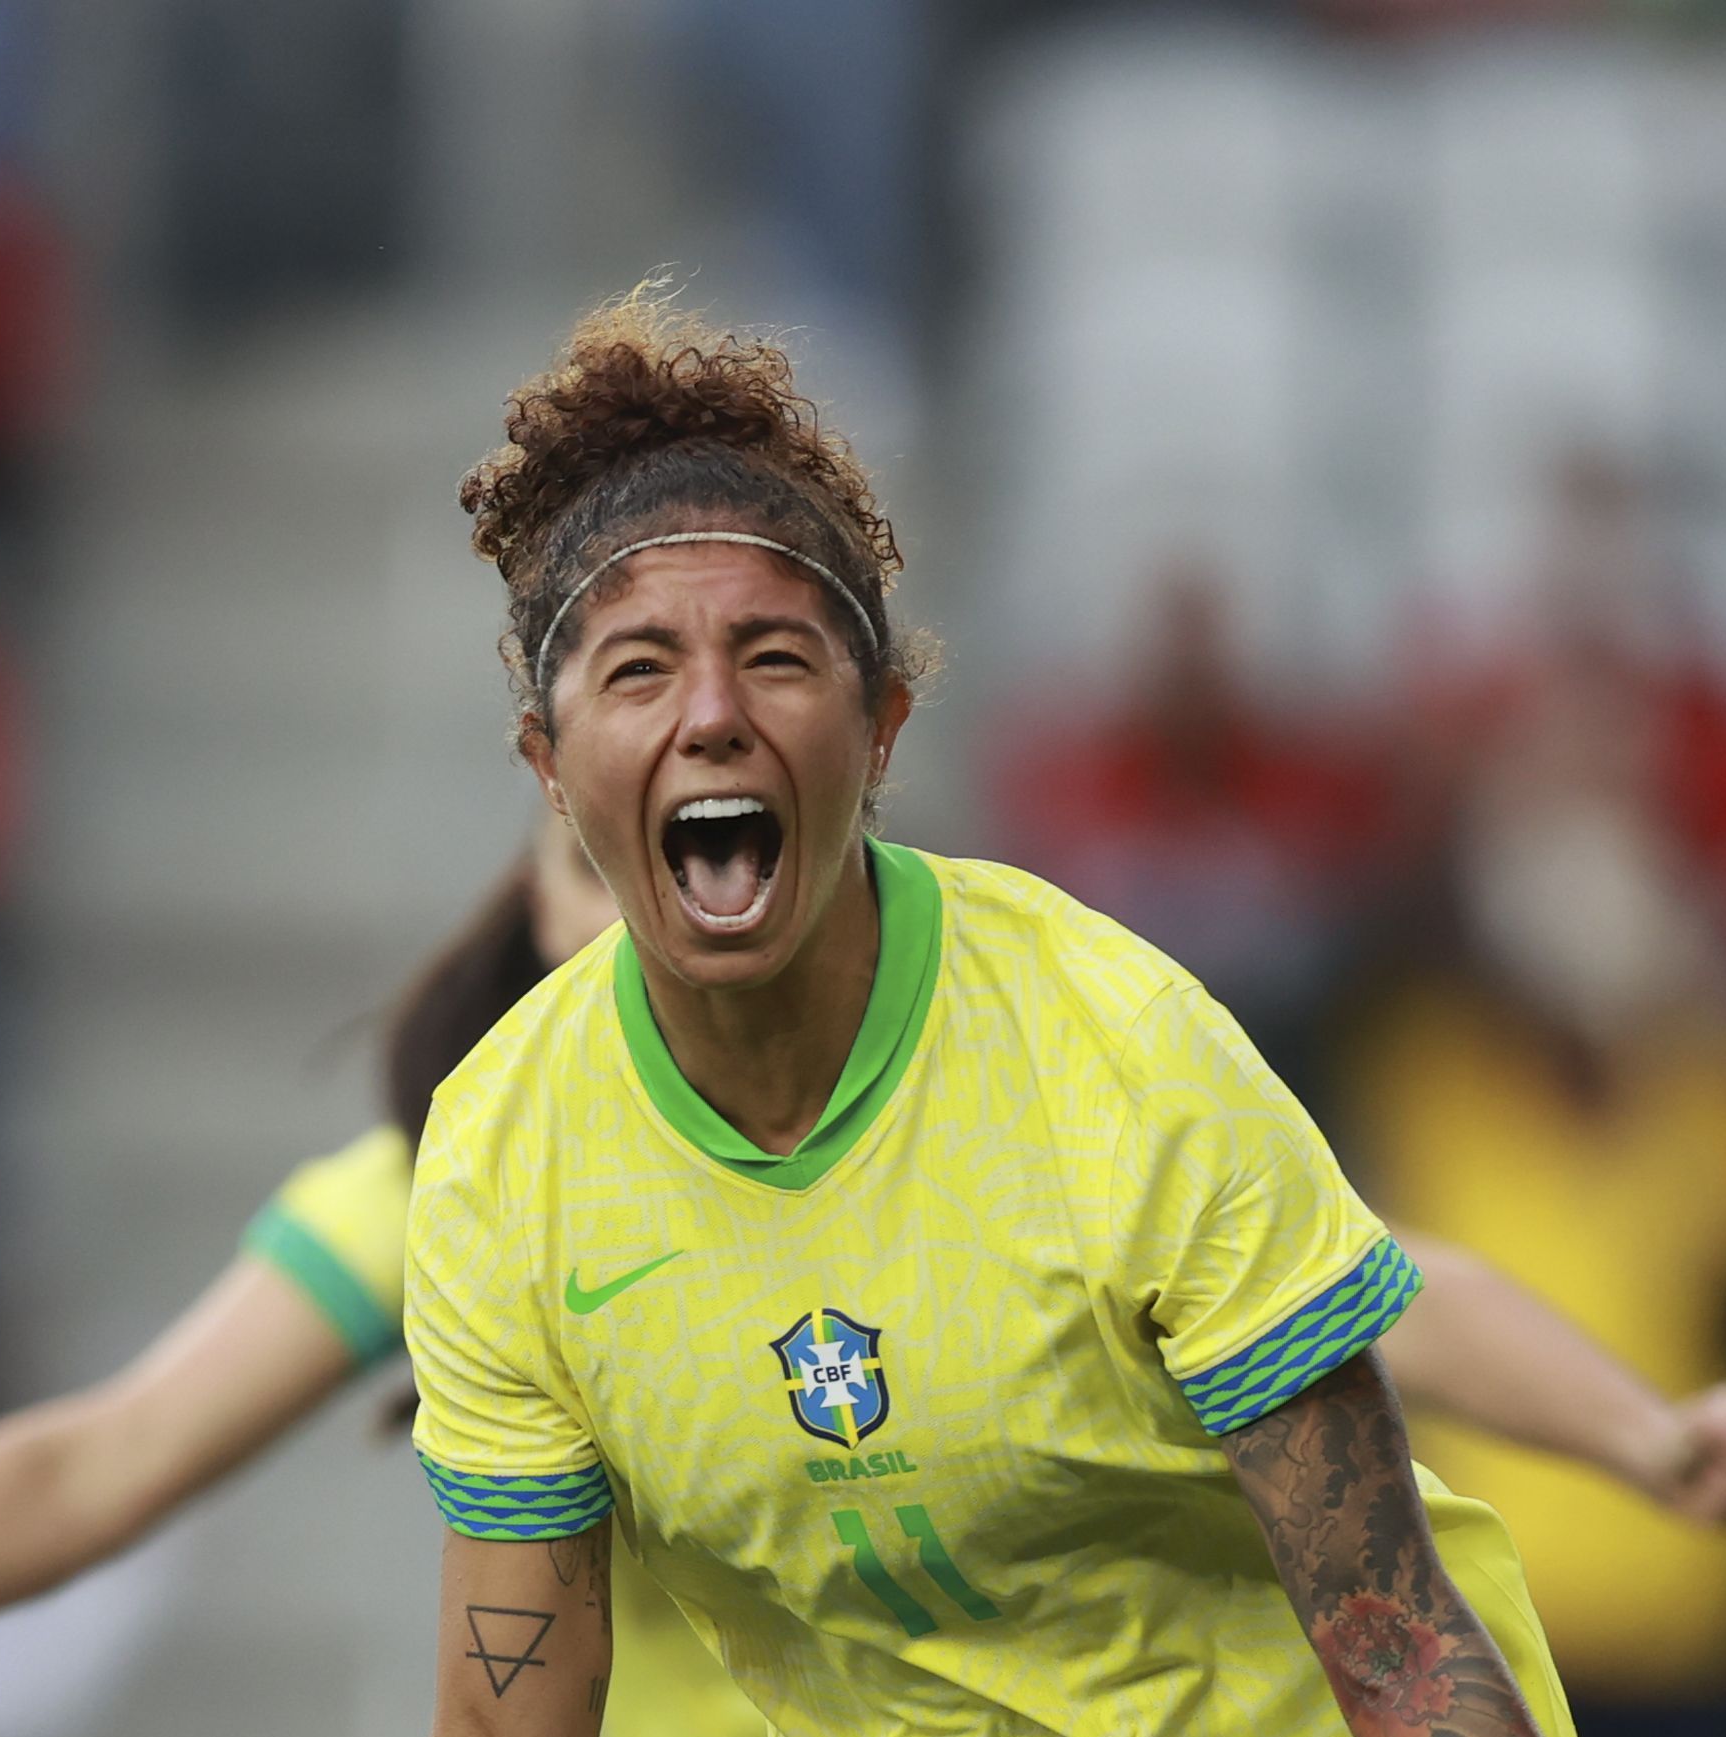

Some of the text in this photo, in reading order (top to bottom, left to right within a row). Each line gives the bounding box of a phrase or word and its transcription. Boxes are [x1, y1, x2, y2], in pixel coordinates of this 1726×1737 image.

[812, 1363, 852, 1385] CBF
[805, 1450, 918, 1483] BRASIL
[830, 1504, 1003, 1638] 11
